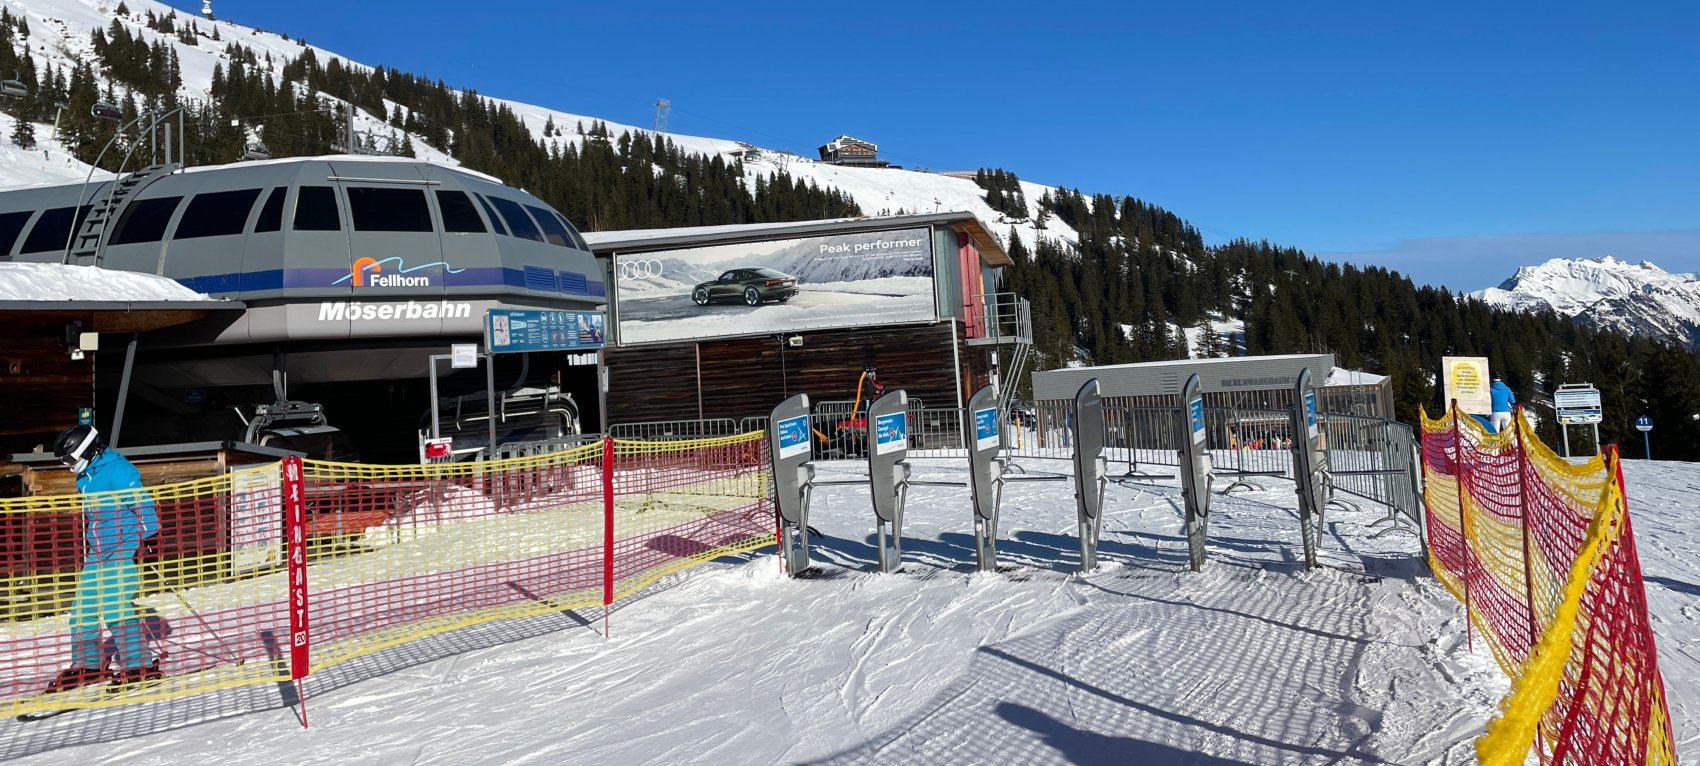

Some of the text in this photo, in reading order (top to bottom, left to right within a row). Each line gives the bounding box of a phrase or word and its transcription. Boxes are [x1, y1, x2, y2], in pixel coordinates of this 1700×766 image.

[820, 238, 922, 254] Peak performer
[370, 274, 429, 287] Fellhorn
[318, 300, 471, 321] Möserbahn
[1639, 417, 1648, 425] 11
[296, 632, 305, 645] 20
